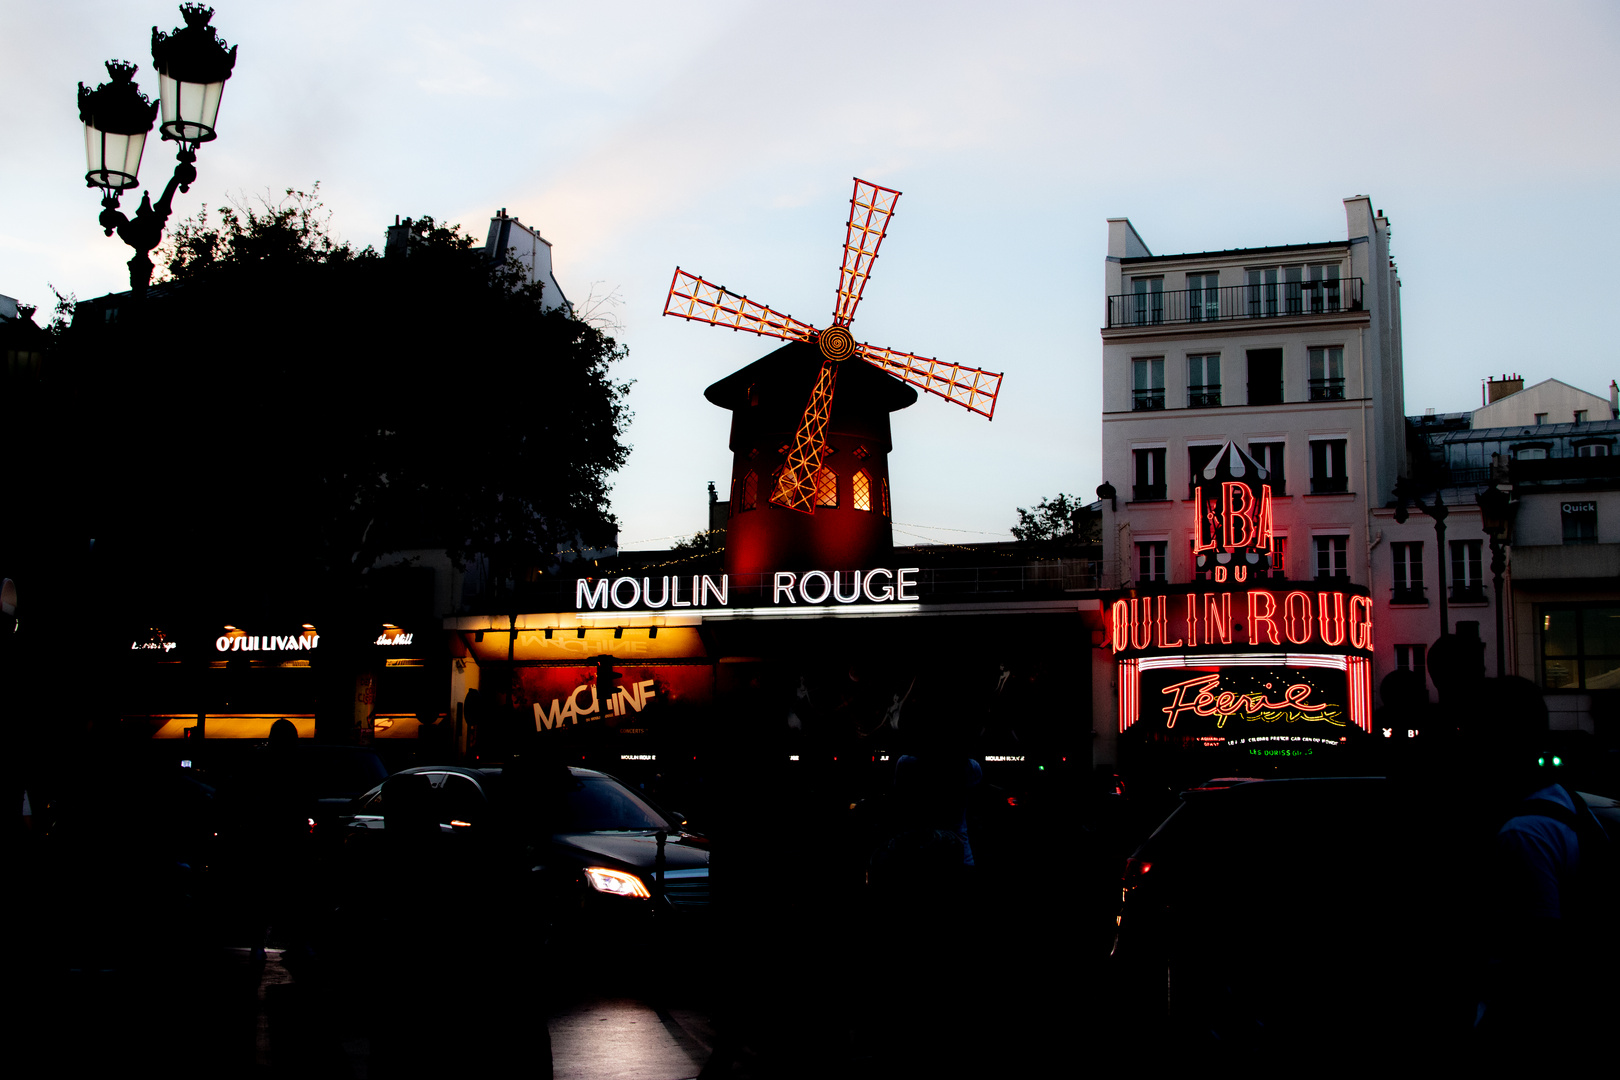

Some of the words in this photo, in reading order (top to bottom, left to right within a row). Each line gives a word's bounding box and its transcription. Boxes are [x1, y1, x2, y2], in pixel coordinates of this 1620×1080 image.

[1562, 502, 1595, 514] Quick
[576, 574, 729, 609] MOULIN
[774, 567, 920, 604] ROUGE
[1214, 565, 1248, 583] DU
[1112, 592, 1232, 655] OULIN
[376, 634, 392, 645] the
[392, 633, 414, 645] Mill
[1161, 673, 1328, 729] Féerie
